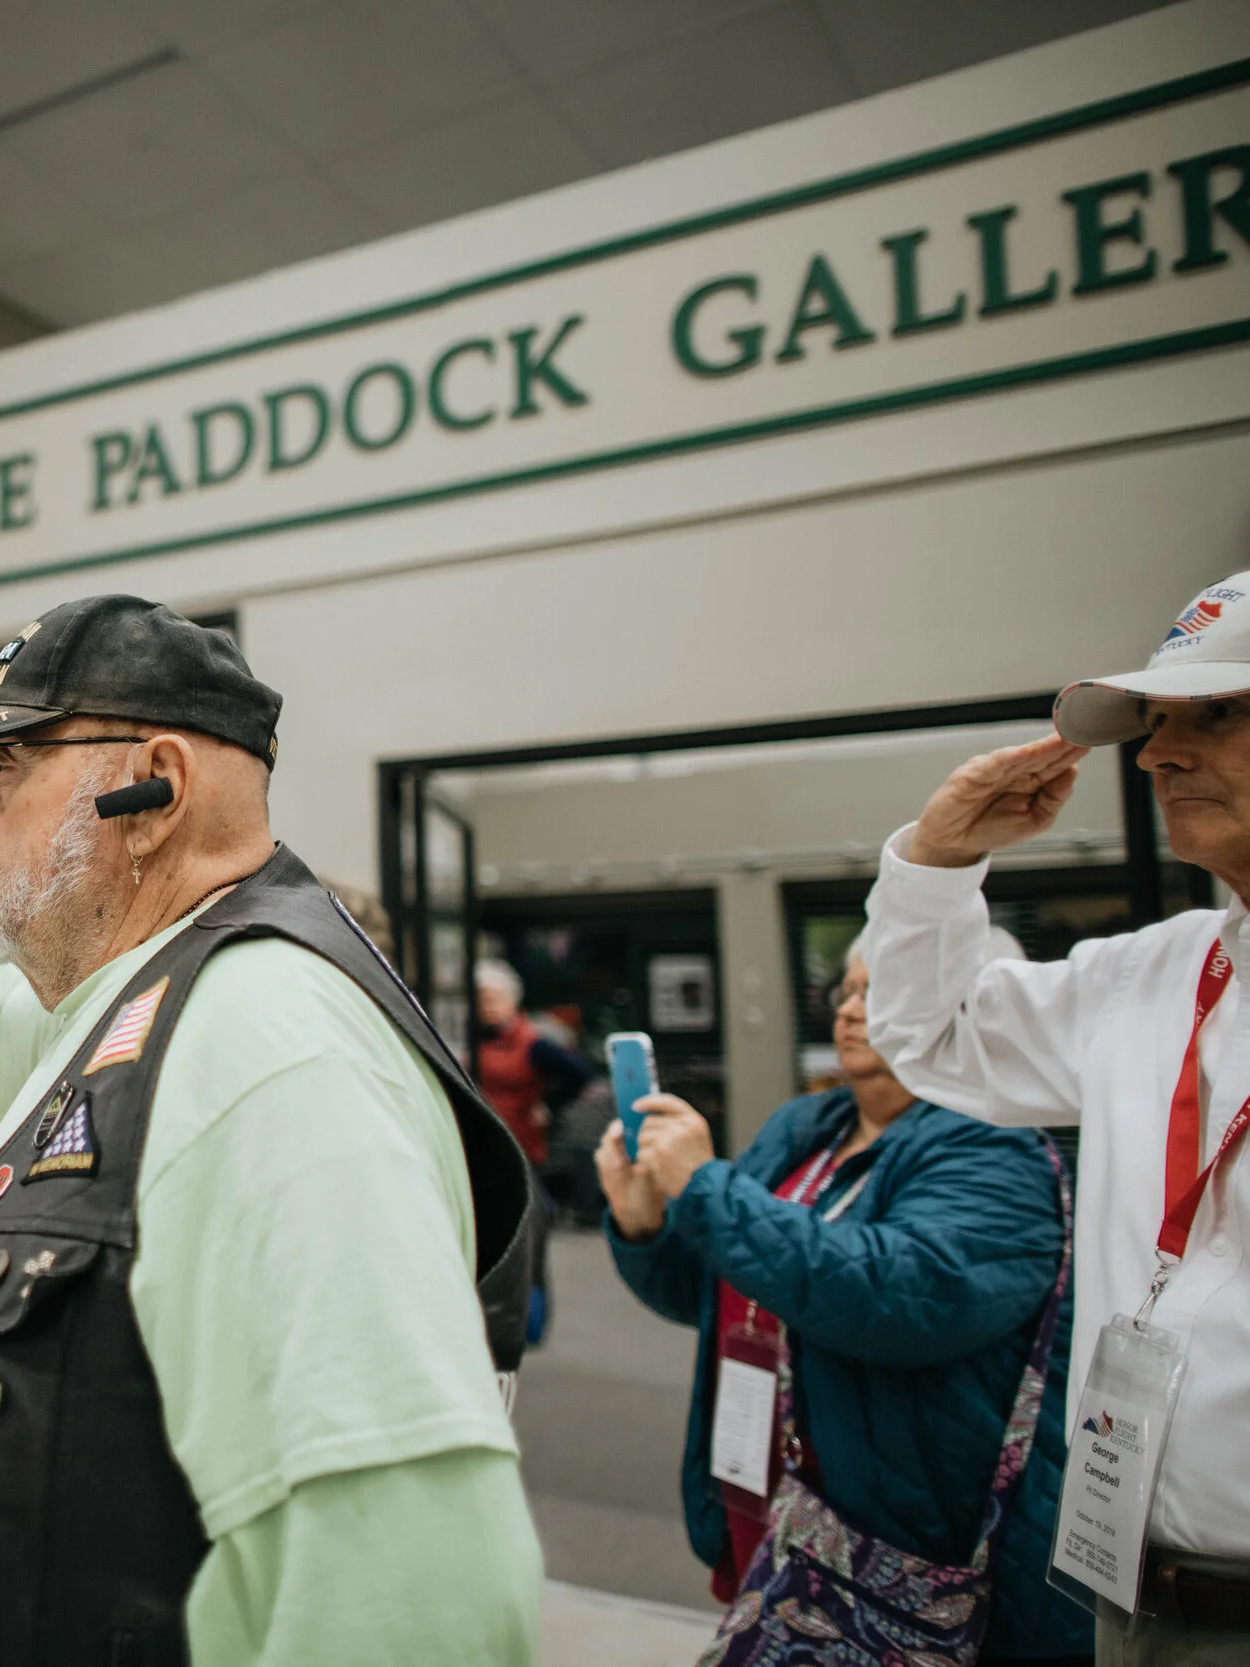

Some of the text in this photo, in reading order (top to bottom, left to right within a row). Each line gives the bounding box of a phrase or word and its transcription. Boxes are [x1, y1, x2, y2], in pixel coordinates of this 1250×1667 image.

[89, 313, 591, 513] PADDOCK
[1110, 1434, 1146, 1456] KENTUCKY
[1113, 1427, 1137, 1443] FLIGHT
[1091, 1441, 1119, 1464] George
[1084, 1461, 1121, 1489] Campbell
